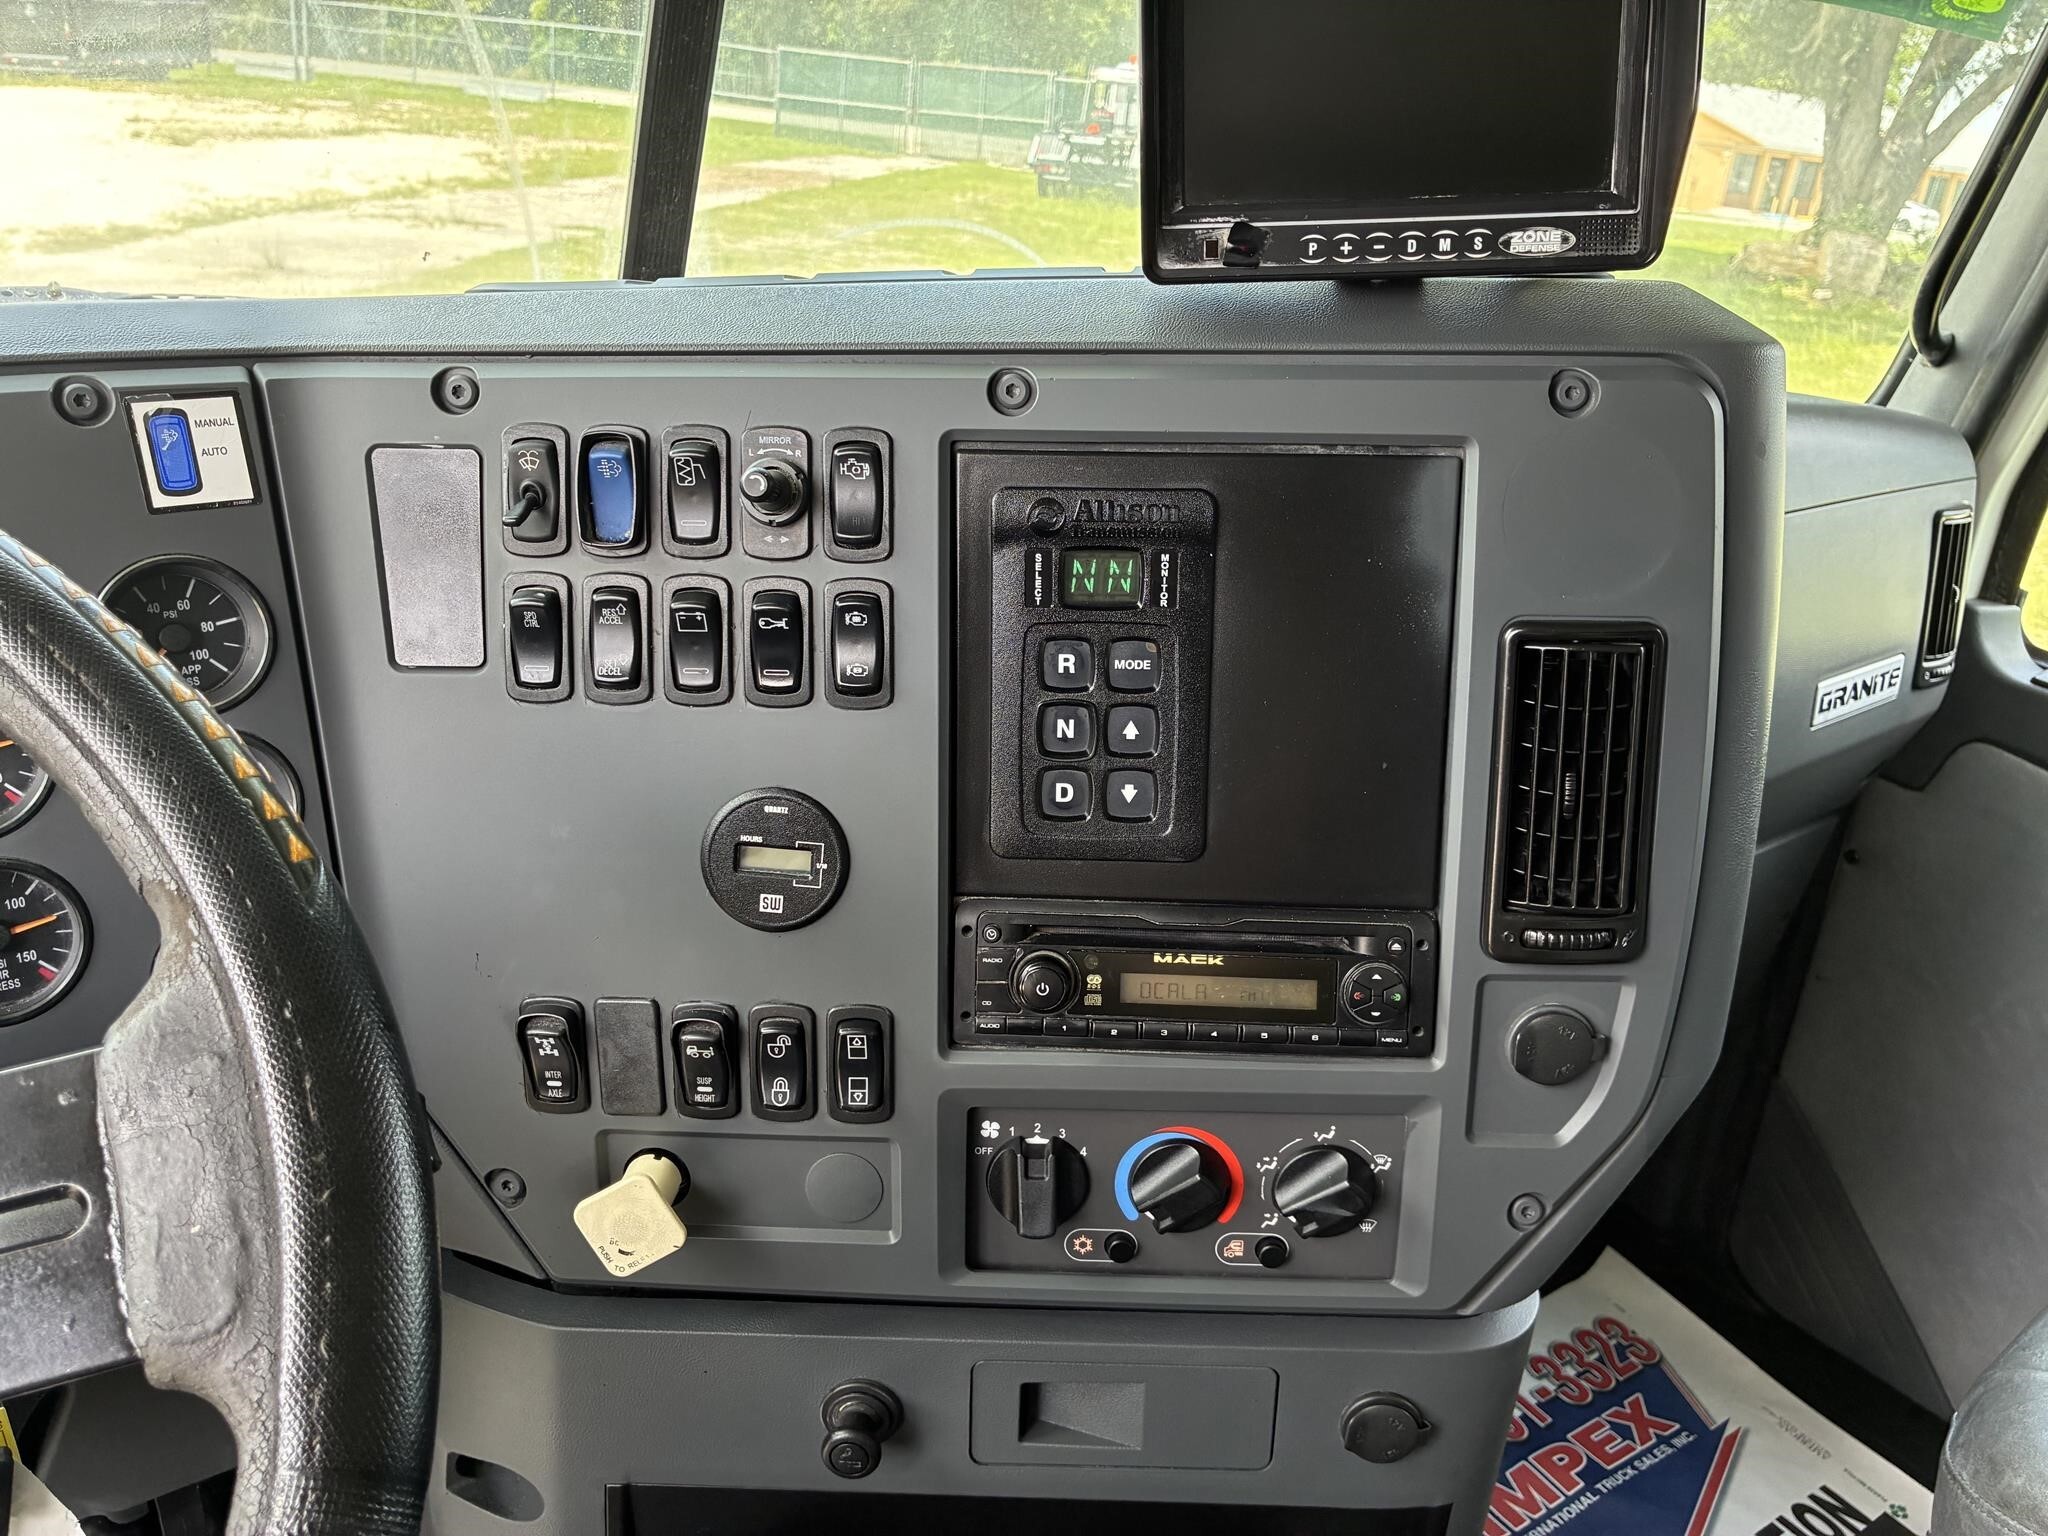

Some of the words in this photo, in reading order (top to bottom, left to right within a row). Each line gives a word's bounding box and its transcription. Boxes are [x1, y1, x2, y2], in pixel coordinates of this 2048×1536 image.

[1510, 230, 1562, 243] ZONE
[1308, 242, 1318, 256] P
[1407, 240, 1417, 253] D
[1439, 238, 1451, 252] M
[1474, 237, 1483, 250] S
[1509, 244, 1561, 253] DEFENSE
[194, 417, 235, 428] MANUAL
[759, 436, 792, 445] MIRROR
[201, 446, 228, 457] AUTO
[748, 448, 754, 456] L
[795, 450, 802, 458] R
[1071, 499, 1181, 523] Allison
[1034, 553, 1042, 606] SELECT
[1160, 553, 1170, 608] MONITOR
[146, 602, 160, 614] 40
[176, 599, 190, 611] 60
[163, 610, 178, 619] PSI
[523, 611, 537, 620] SPD
[602, 608, 616, 616] RES
[524, 620, 540, 628] CTRL
[599, 616, 624, 625] ACCEL
[200, 621, 215, 633] 80
[189, 648, 210, 661] 100
[181, 664, 202, 676] APP
[1058, 654, 1076, 674] R
[1114, 659, 1152, 671] MODE
[598, 667, 623, 676] DECEL
[1056, 719, 1075, 739] N
[1055, 783, 1074, 803] D
[740, 834, 763, 843] HOURS
[4, 896, 26, 910] 100
[762, 896, 782, 911] SW
[16, 950, 38, 964] 150
[1139, 981, 1208, 1000] OCALA
[1210, 1030, 1218, 1038] 4
[1260, 1032, 1268, 1040] 5
[544, 1070, 562, 1079] INTER
[696, 1076, 713, 1085] SUSP
[548, 1089, 563, 1098] AXLE
[694, 1094, 716, 1103] HEIGHT
[1008, 1126, 1015, 1136] 1
[1034, 1122, 1042, 1134] 2
[1059, 1128, 1066, 1139] 3
[1080, 1146, 1088, 1157] 4
[974, 1146, 994, 1156] OFF
[598, 1245, 614, 1264] PUSH
[614, 1264, 626, 1273] TO
[1594, 1465, 1640, 1494] TRUCK
